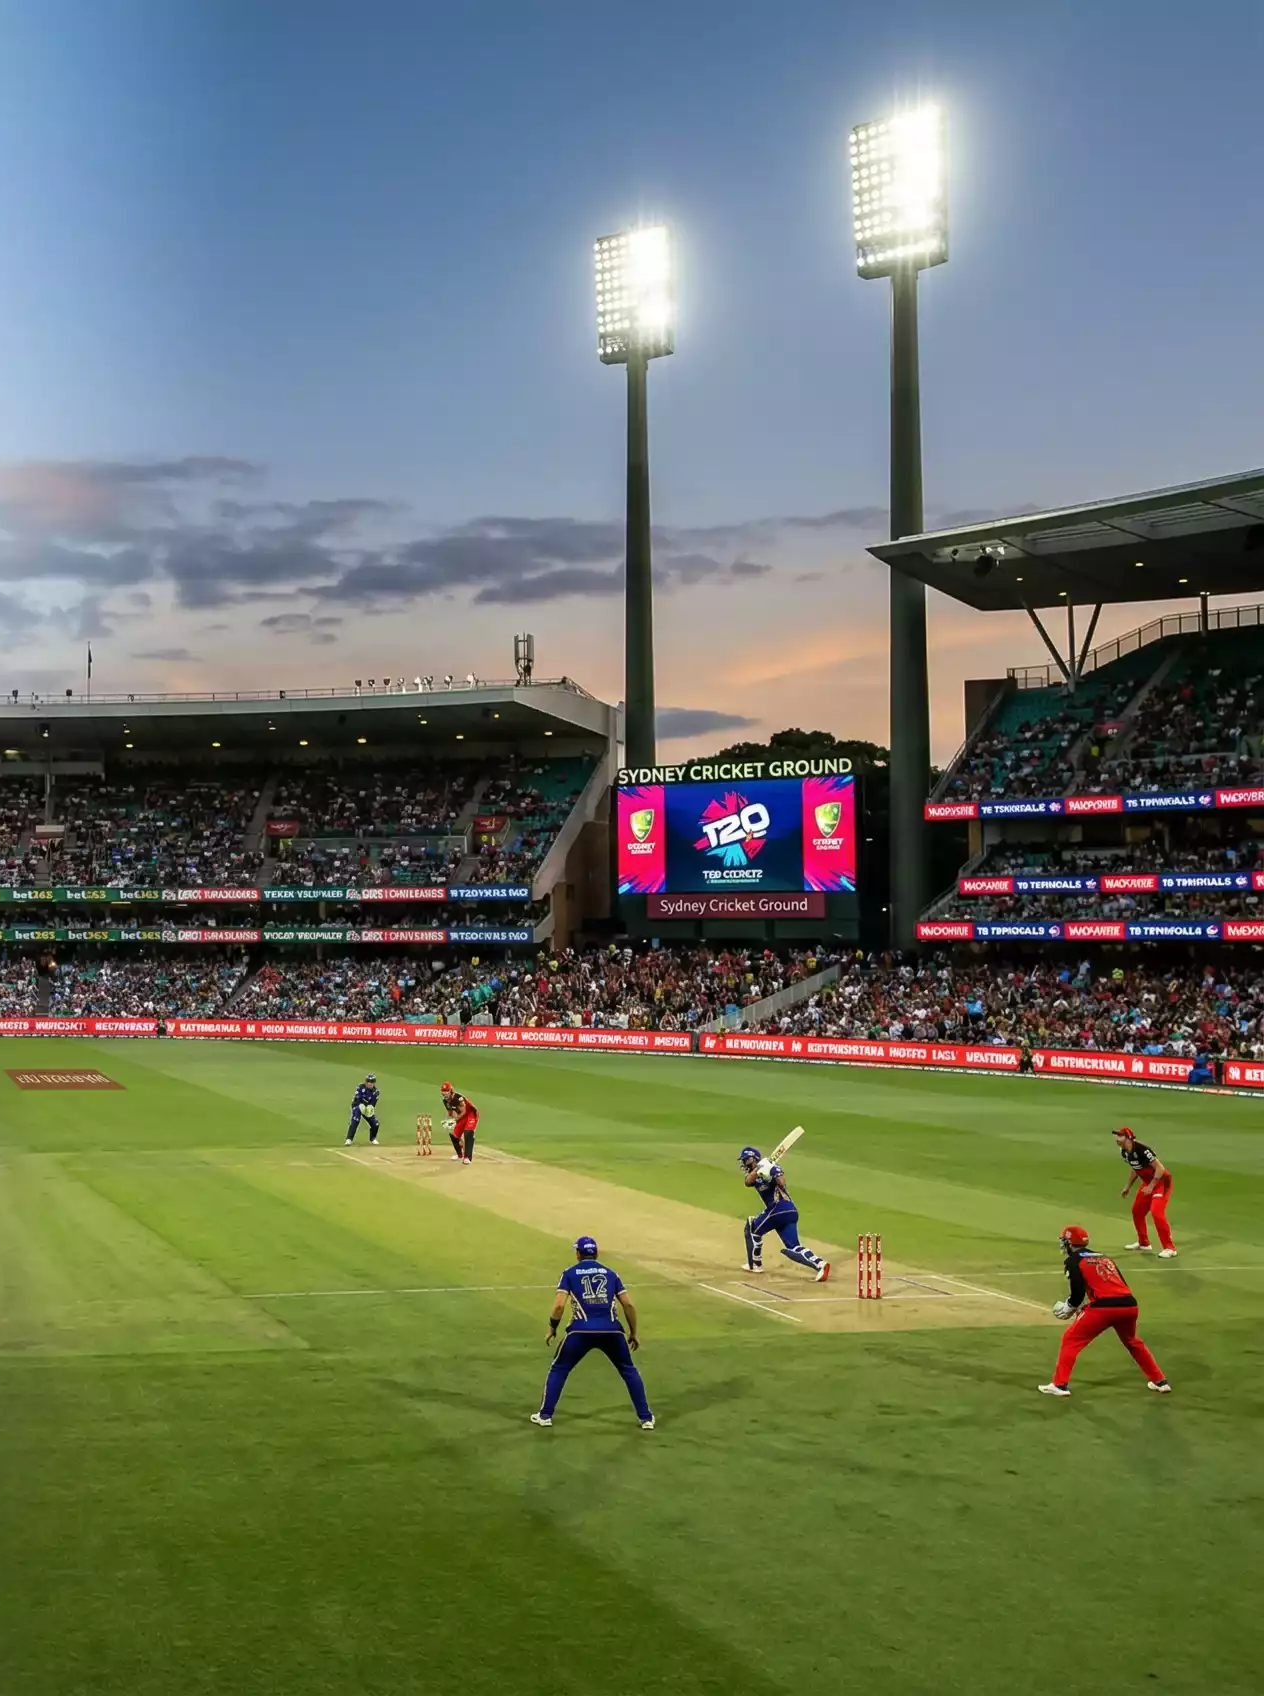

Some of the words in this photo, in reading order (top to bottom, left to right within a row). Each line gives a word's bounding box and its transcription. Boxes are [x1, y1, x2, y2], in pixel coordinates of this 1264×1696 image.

[618, 766, 686, 784] SYDNEY
[690, 762, 765, 781] CRICKET
[769, 758, 852, 776] GROUND
[702, 803, 771, 848] T20
[660, 899, 706, 915] Sydney
[709, 898, 756, 912] Cricket
[759, 897, 808, 911] Ground
[581, 1274, 608, 1299] 12
